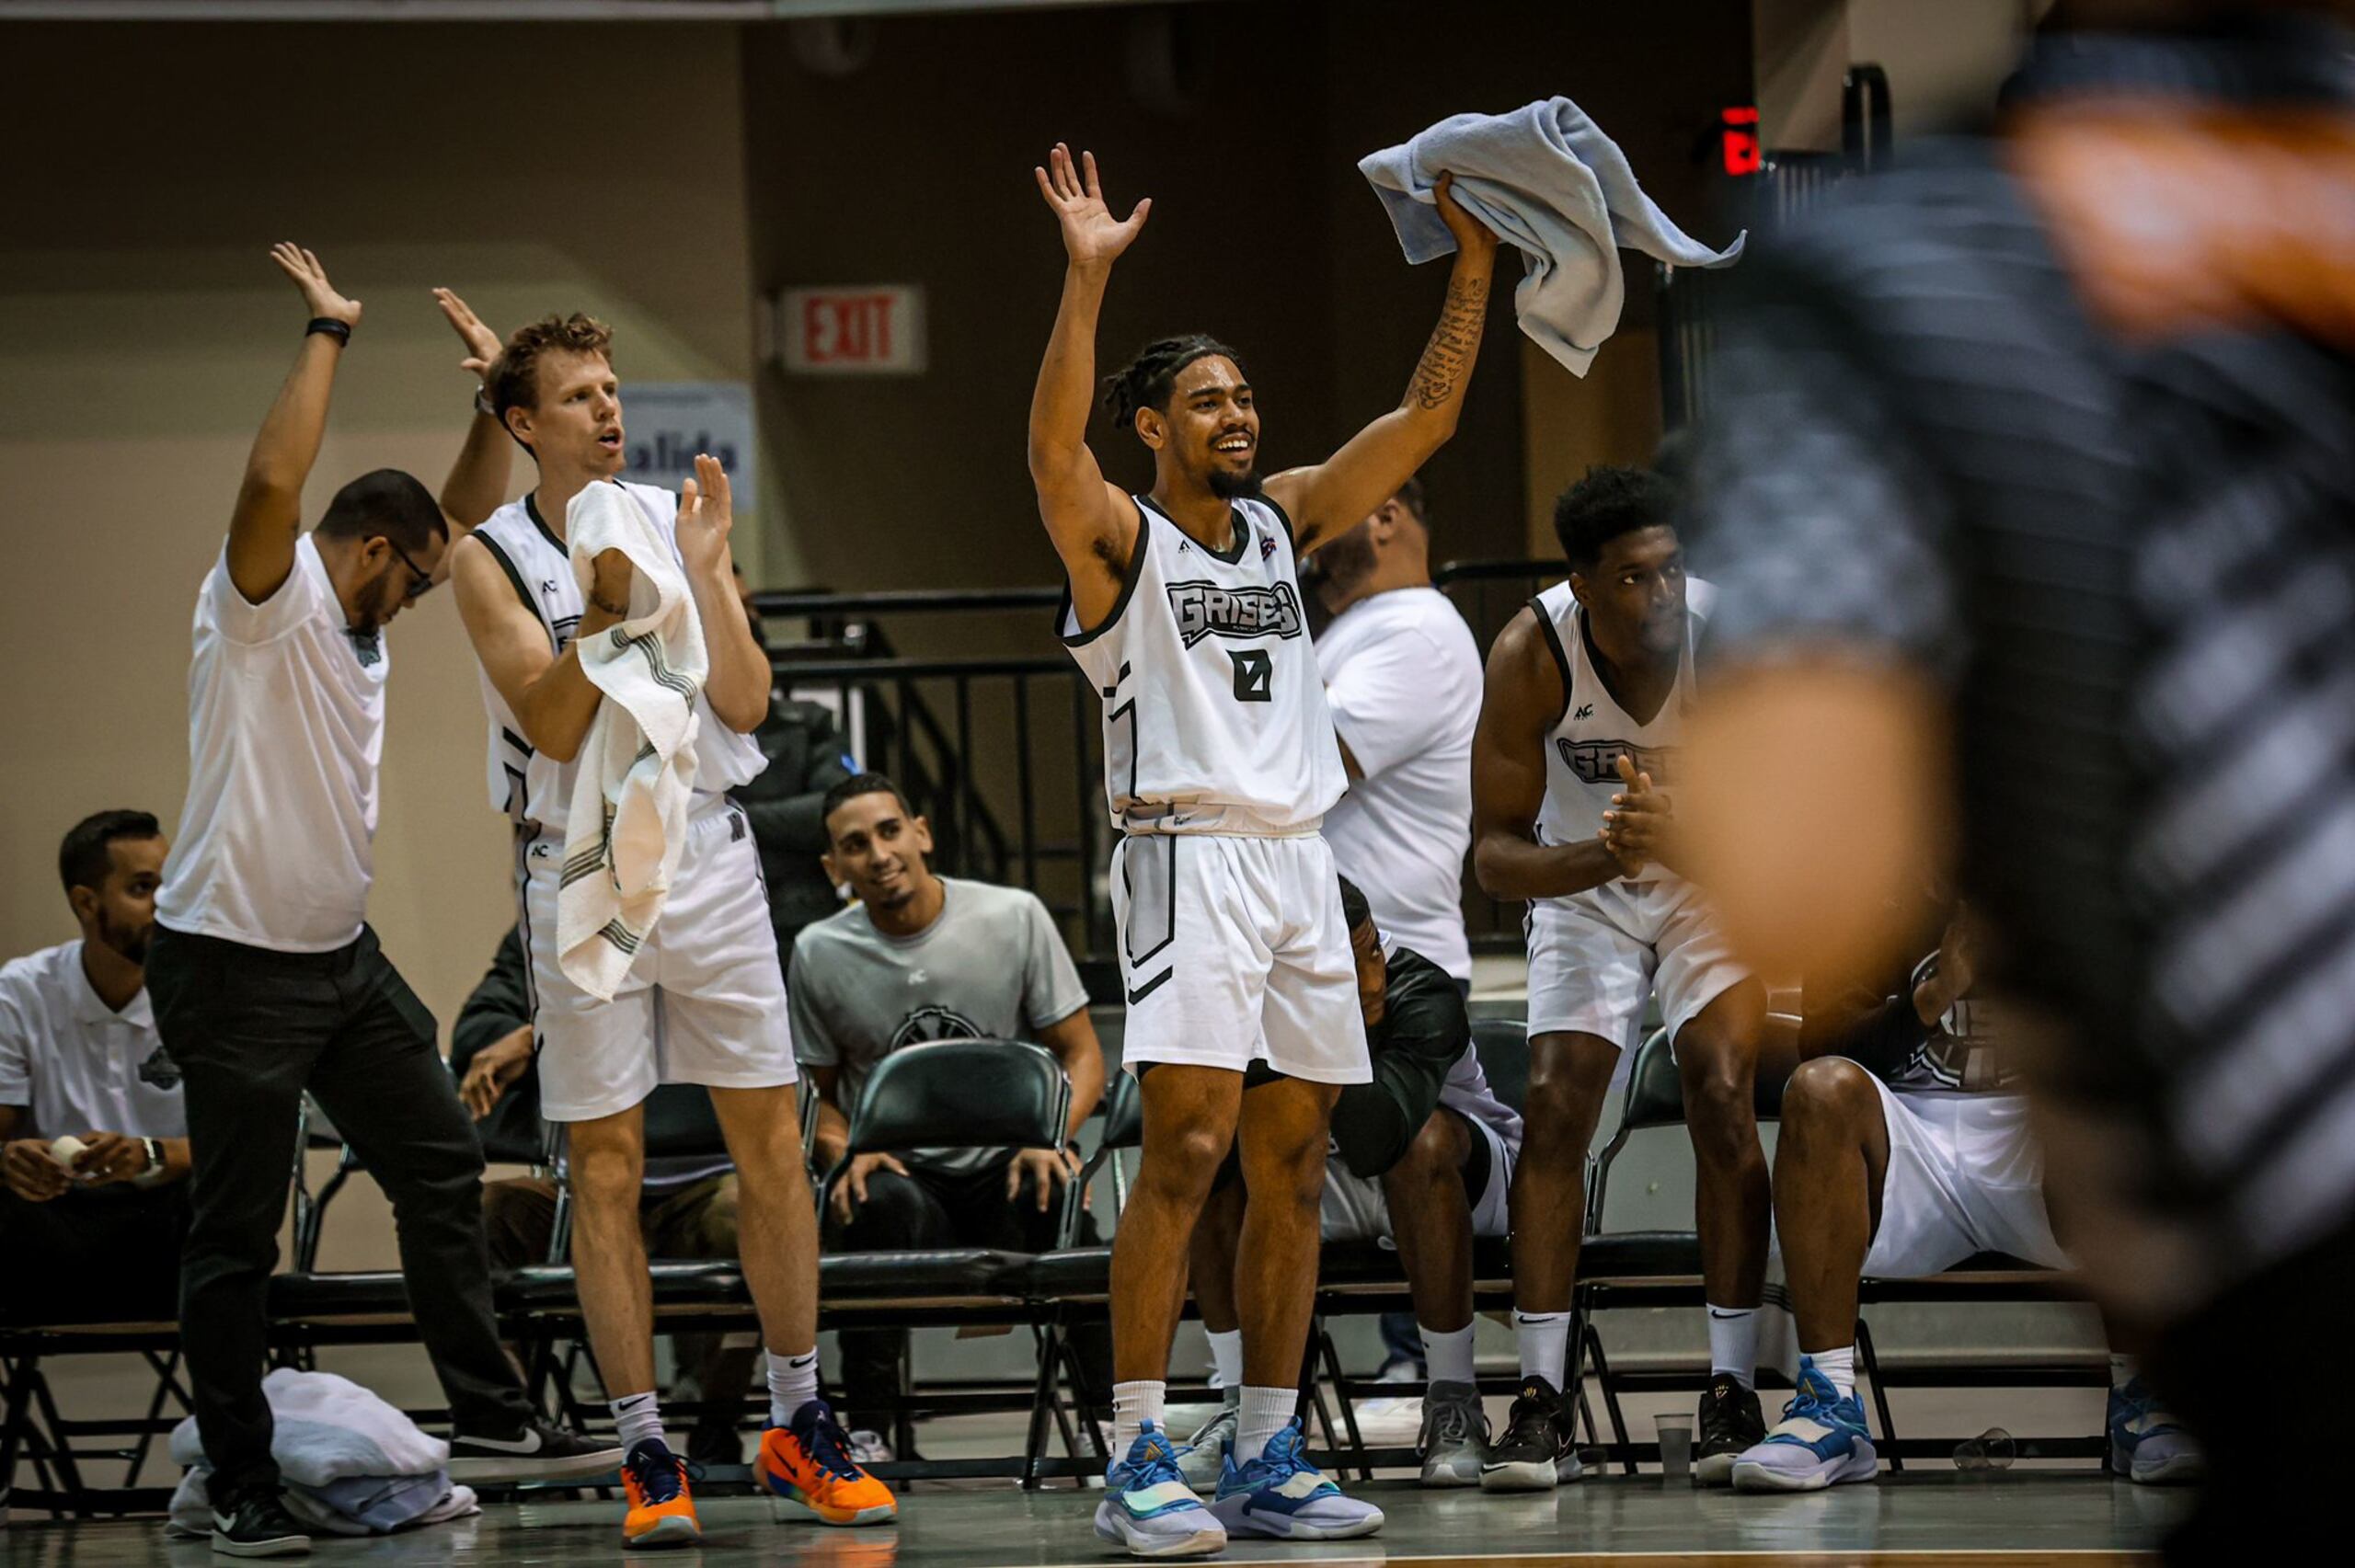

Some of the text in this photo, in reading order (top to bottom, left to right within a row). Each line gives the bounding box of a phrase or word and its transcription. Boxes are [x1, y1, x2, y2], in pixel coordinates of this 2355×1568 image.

[802, 294, 897, 362] EXIT
[630, 430, 739, 474] alida
[1169, 585, 1300, 638] GRISES
[1226, 649, 1272, 702] 0
